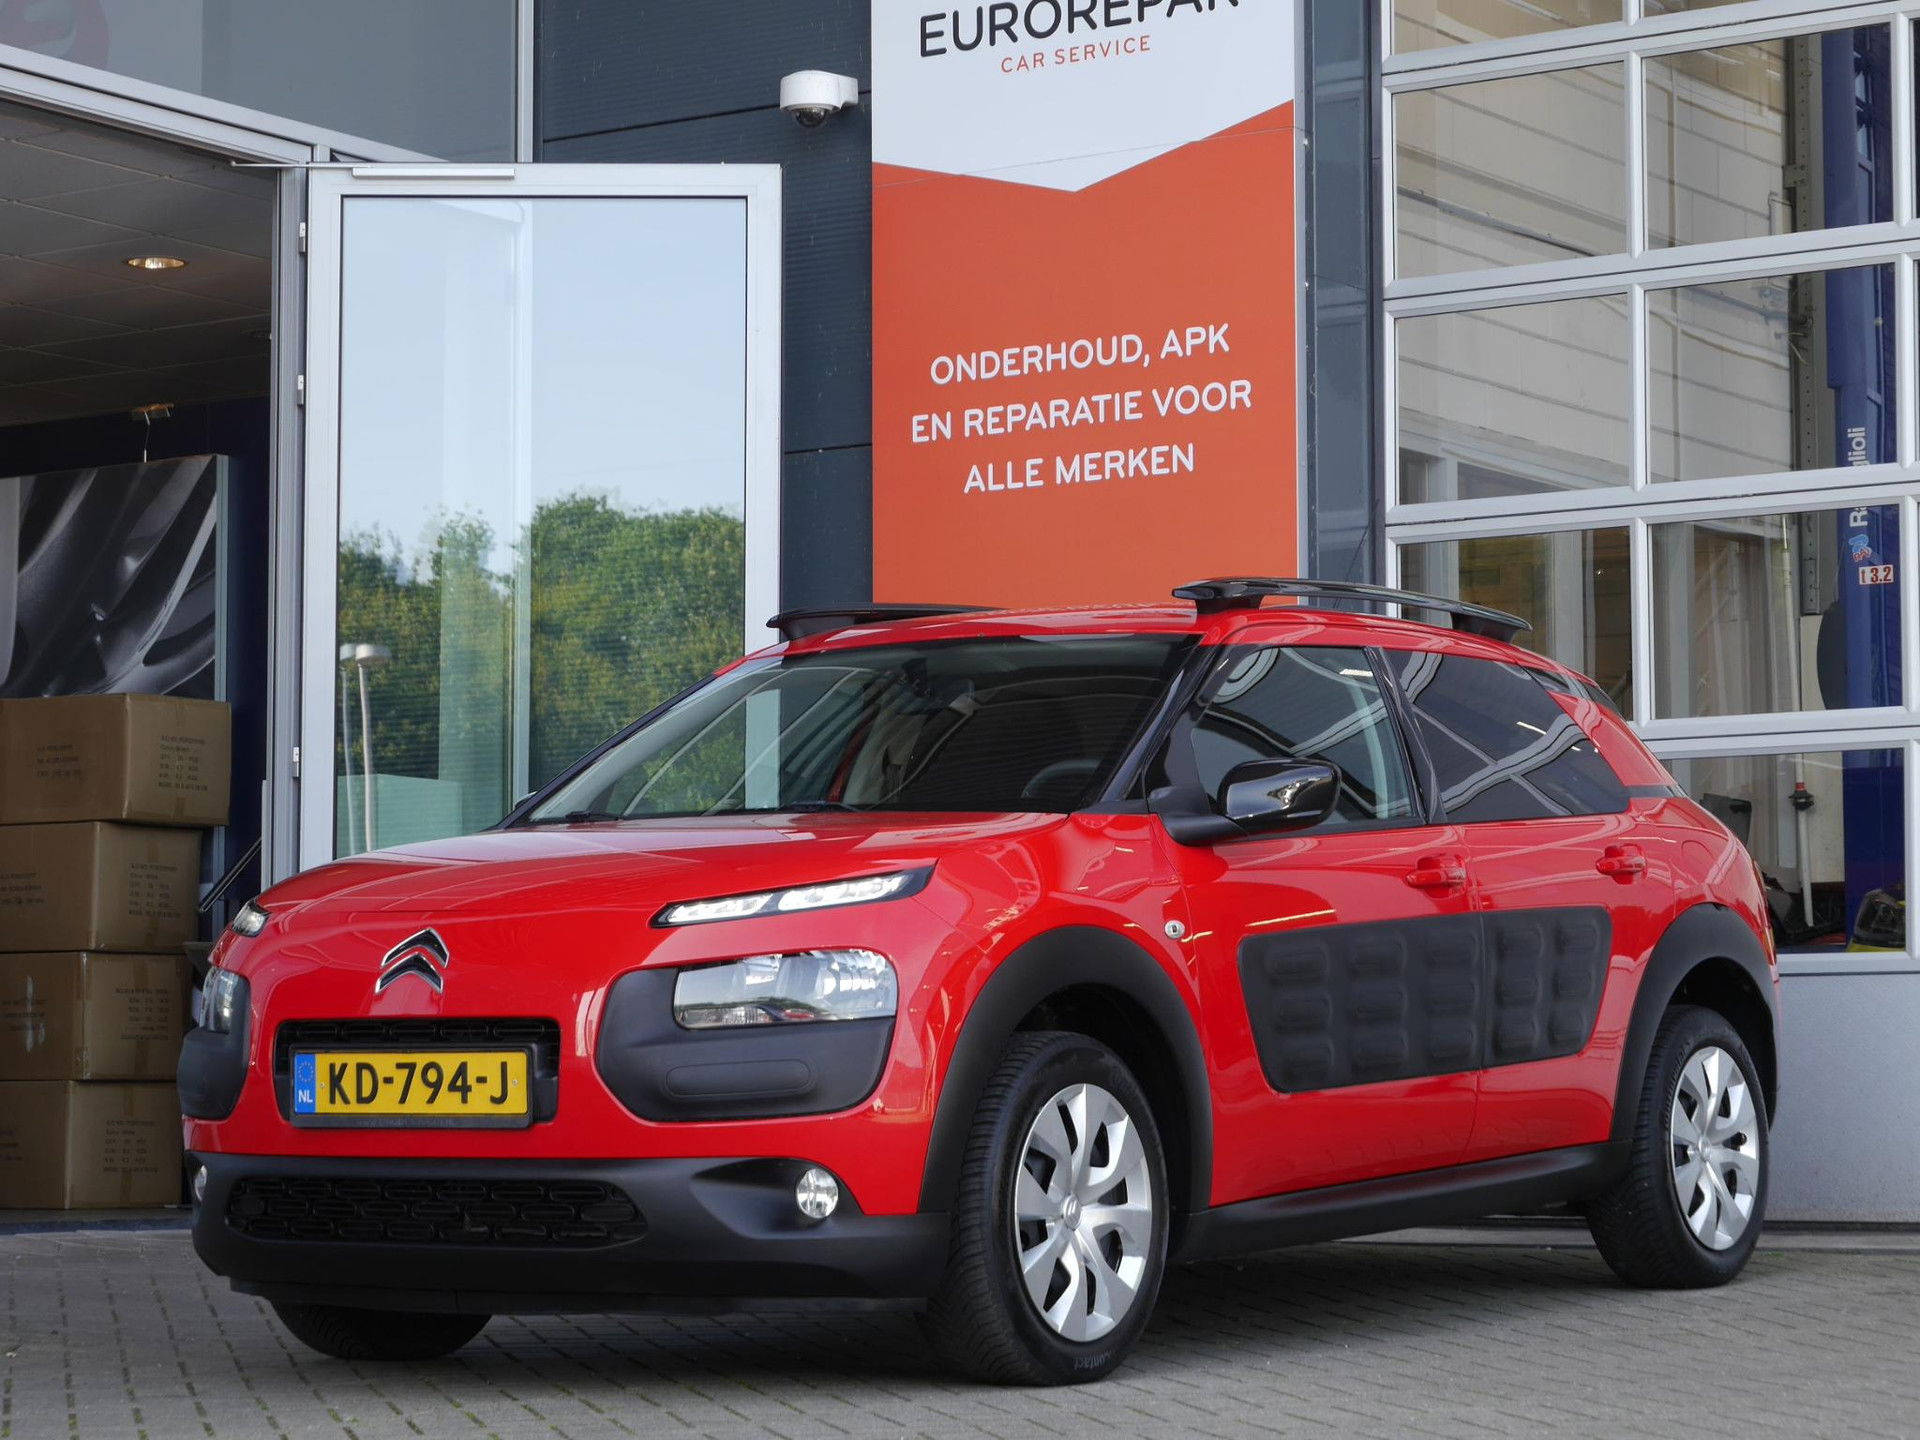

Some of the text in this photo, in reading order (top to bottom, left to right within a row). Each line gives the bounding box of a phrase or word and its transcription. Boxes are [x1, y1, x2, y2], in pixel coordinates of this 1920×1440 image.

[919, 0, 1239, 58] EUROREP
[1000, 35, 1151, 74] CAR SERVICE
[930, 322, 1230, 385] ONDERHOUD, APK
[911, 379, 1252, 443] EN REPARATIE VOOR
[963, 442, 1195, 494] ALLE MERKEN
[1870, 566, 1892, 583] 3.2
[297, 1089, 313, 1103] NL
[328, 1061, 510, 1105] KD-794-J
